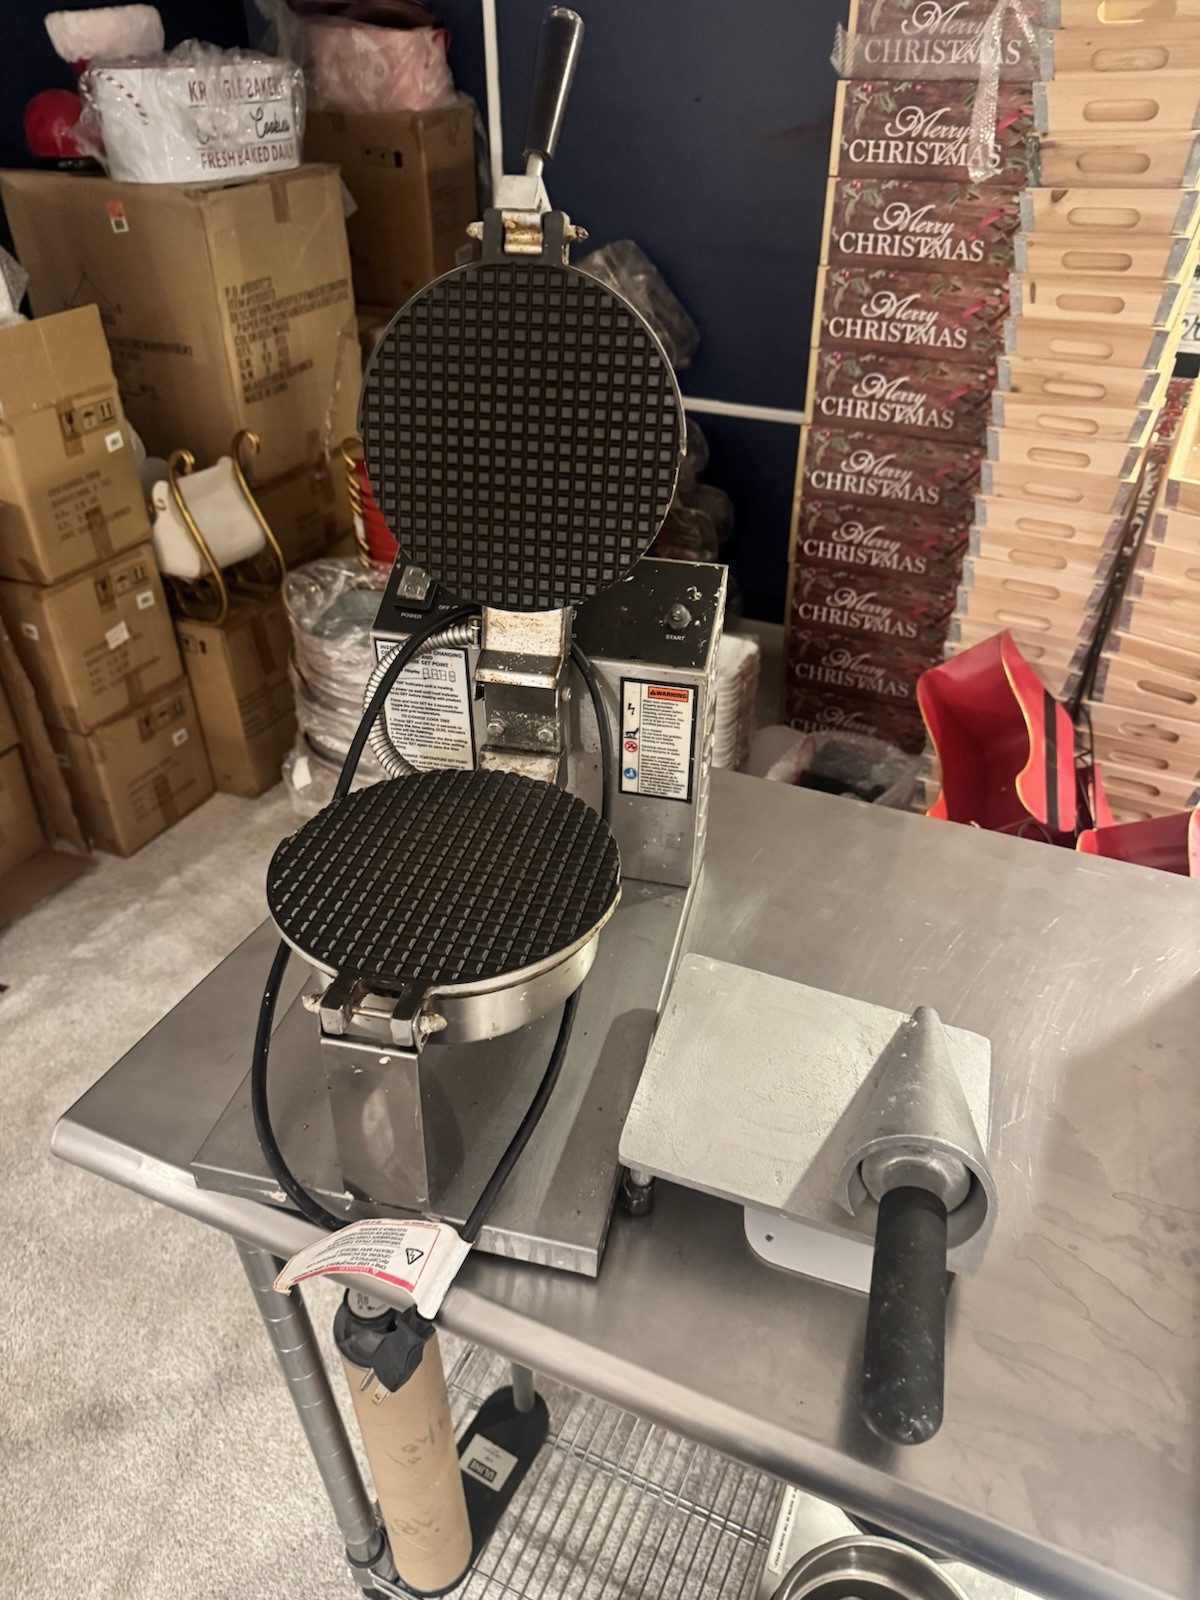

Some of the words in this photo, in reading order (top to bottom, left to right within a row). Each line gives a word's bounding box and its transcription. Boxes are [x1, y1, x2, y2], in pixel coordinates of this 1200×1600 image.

[884, 105, 972, 162] Merry
[201, 151, 236, 169] FRESH
[238, 146, 270, 166] BAKED
[849, 139, 1002, 168] CHRISTMAS
[839, 231, 985, 262] CHRISTMAS
[873, 202, 954, 257] Merry
[829, 317, 968, 349] CHRISTMAS
[861, 290, 939, 343] Merry
[821, 396, 955, 429] CHRISTMAS
[852, 372, 927, 422] Merry
[811, 470, 940, 505] CHRISTMAS
[841, 449, 913, 496] Merry
[803, 539, 927, 574] CHRISTMAS
[832, 521, 900, 565] Merry
[798, 603, 918, 638] CHRISTMAS
[826, 587, 893, 629] Merry
[795, 663, 909, 698] CHRISTMAS
[821, 648, 886, 686] Merry
[470, 1460, 495, 1481] ULINE
